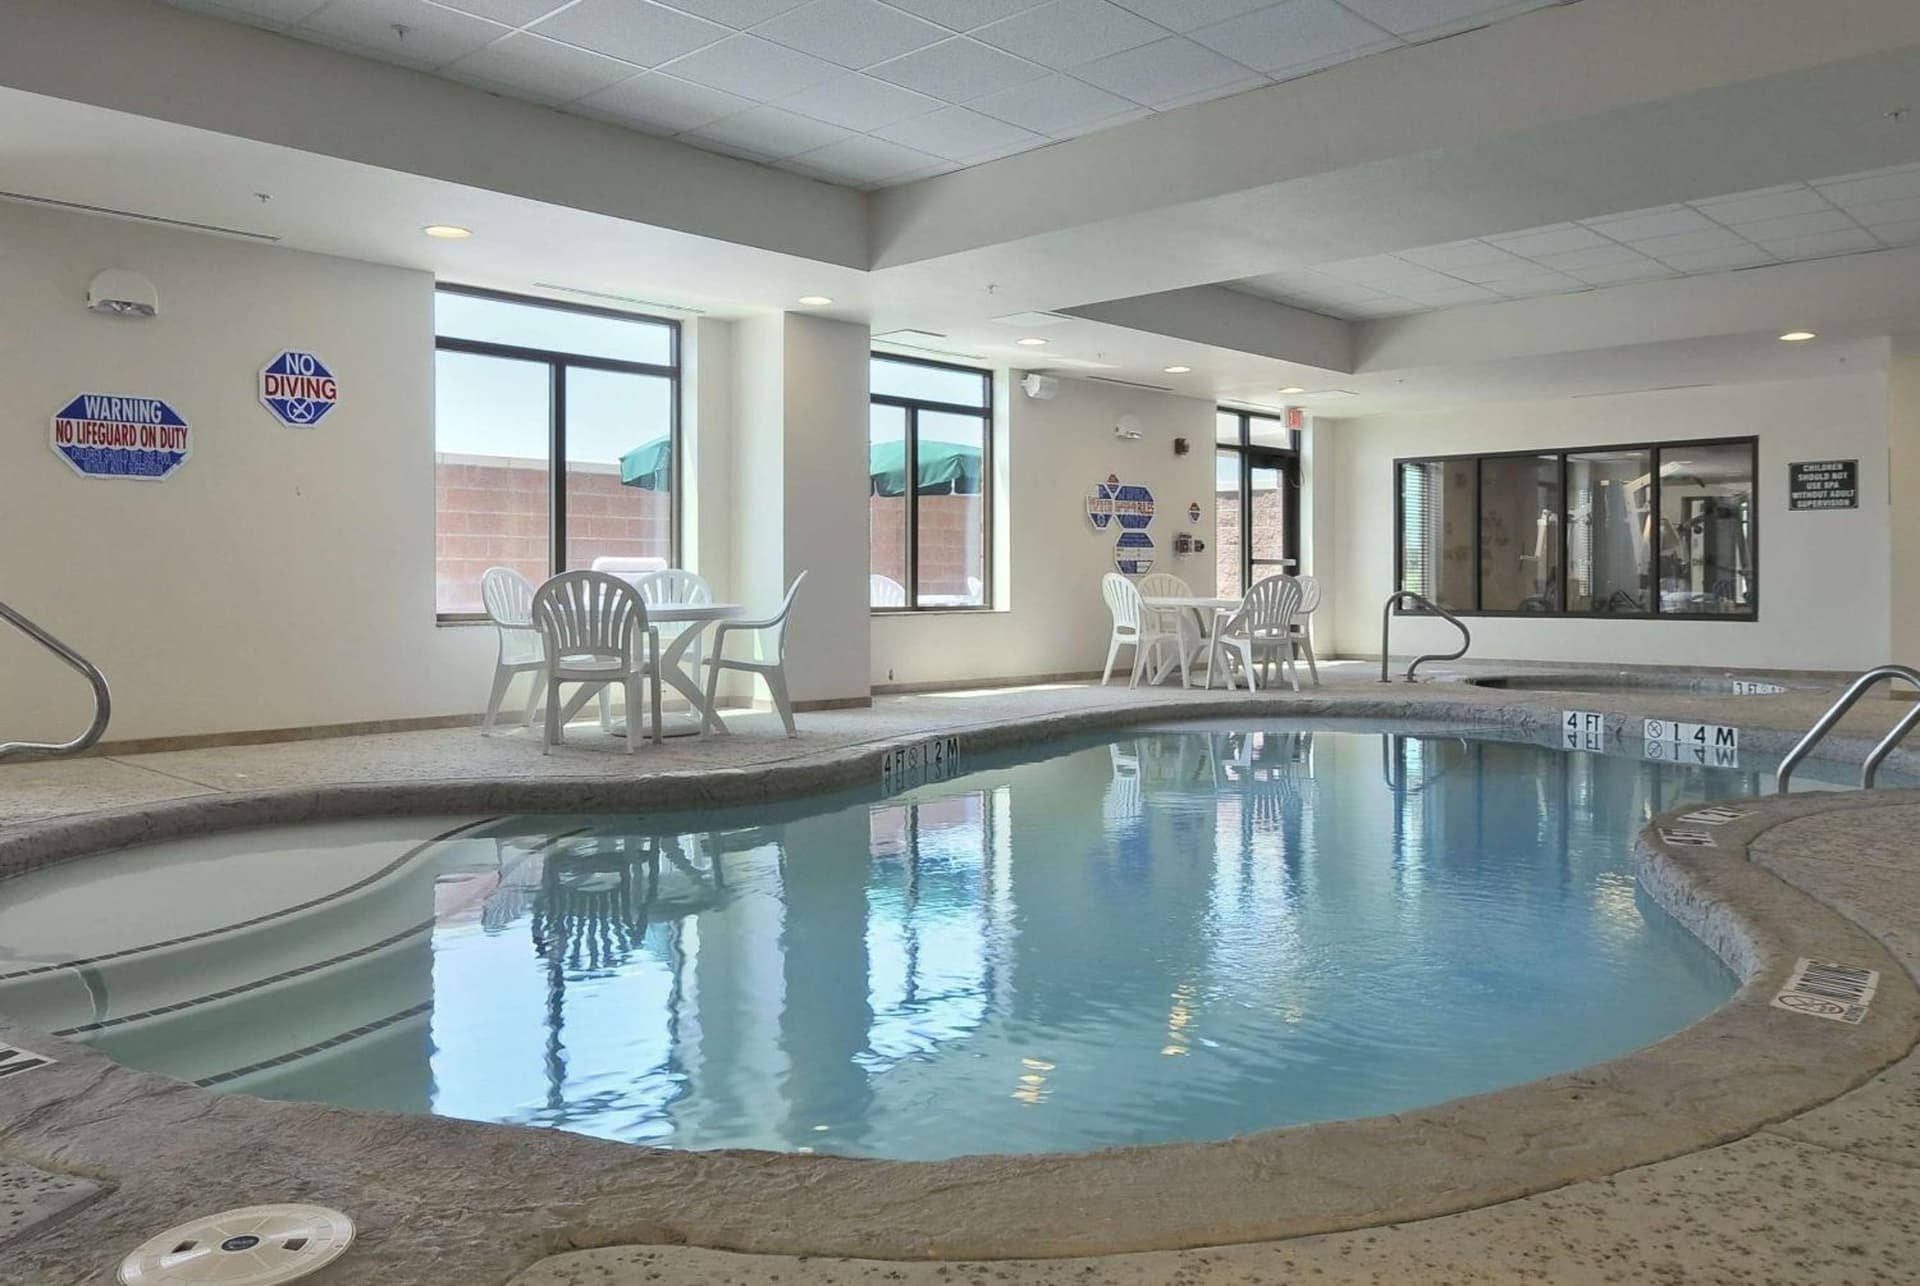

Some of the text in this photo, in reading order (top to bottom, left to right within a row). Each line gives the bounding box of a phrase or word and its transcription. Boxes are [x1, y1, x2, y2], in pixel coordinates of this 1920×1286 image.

[285, 353, 315, 375] NO
[265, 374, 337, 400] DIVING
[84, 396, 162, 423] WARNING
[55, 420, 188, 449] NO LIFEGUARD ON DUTY
